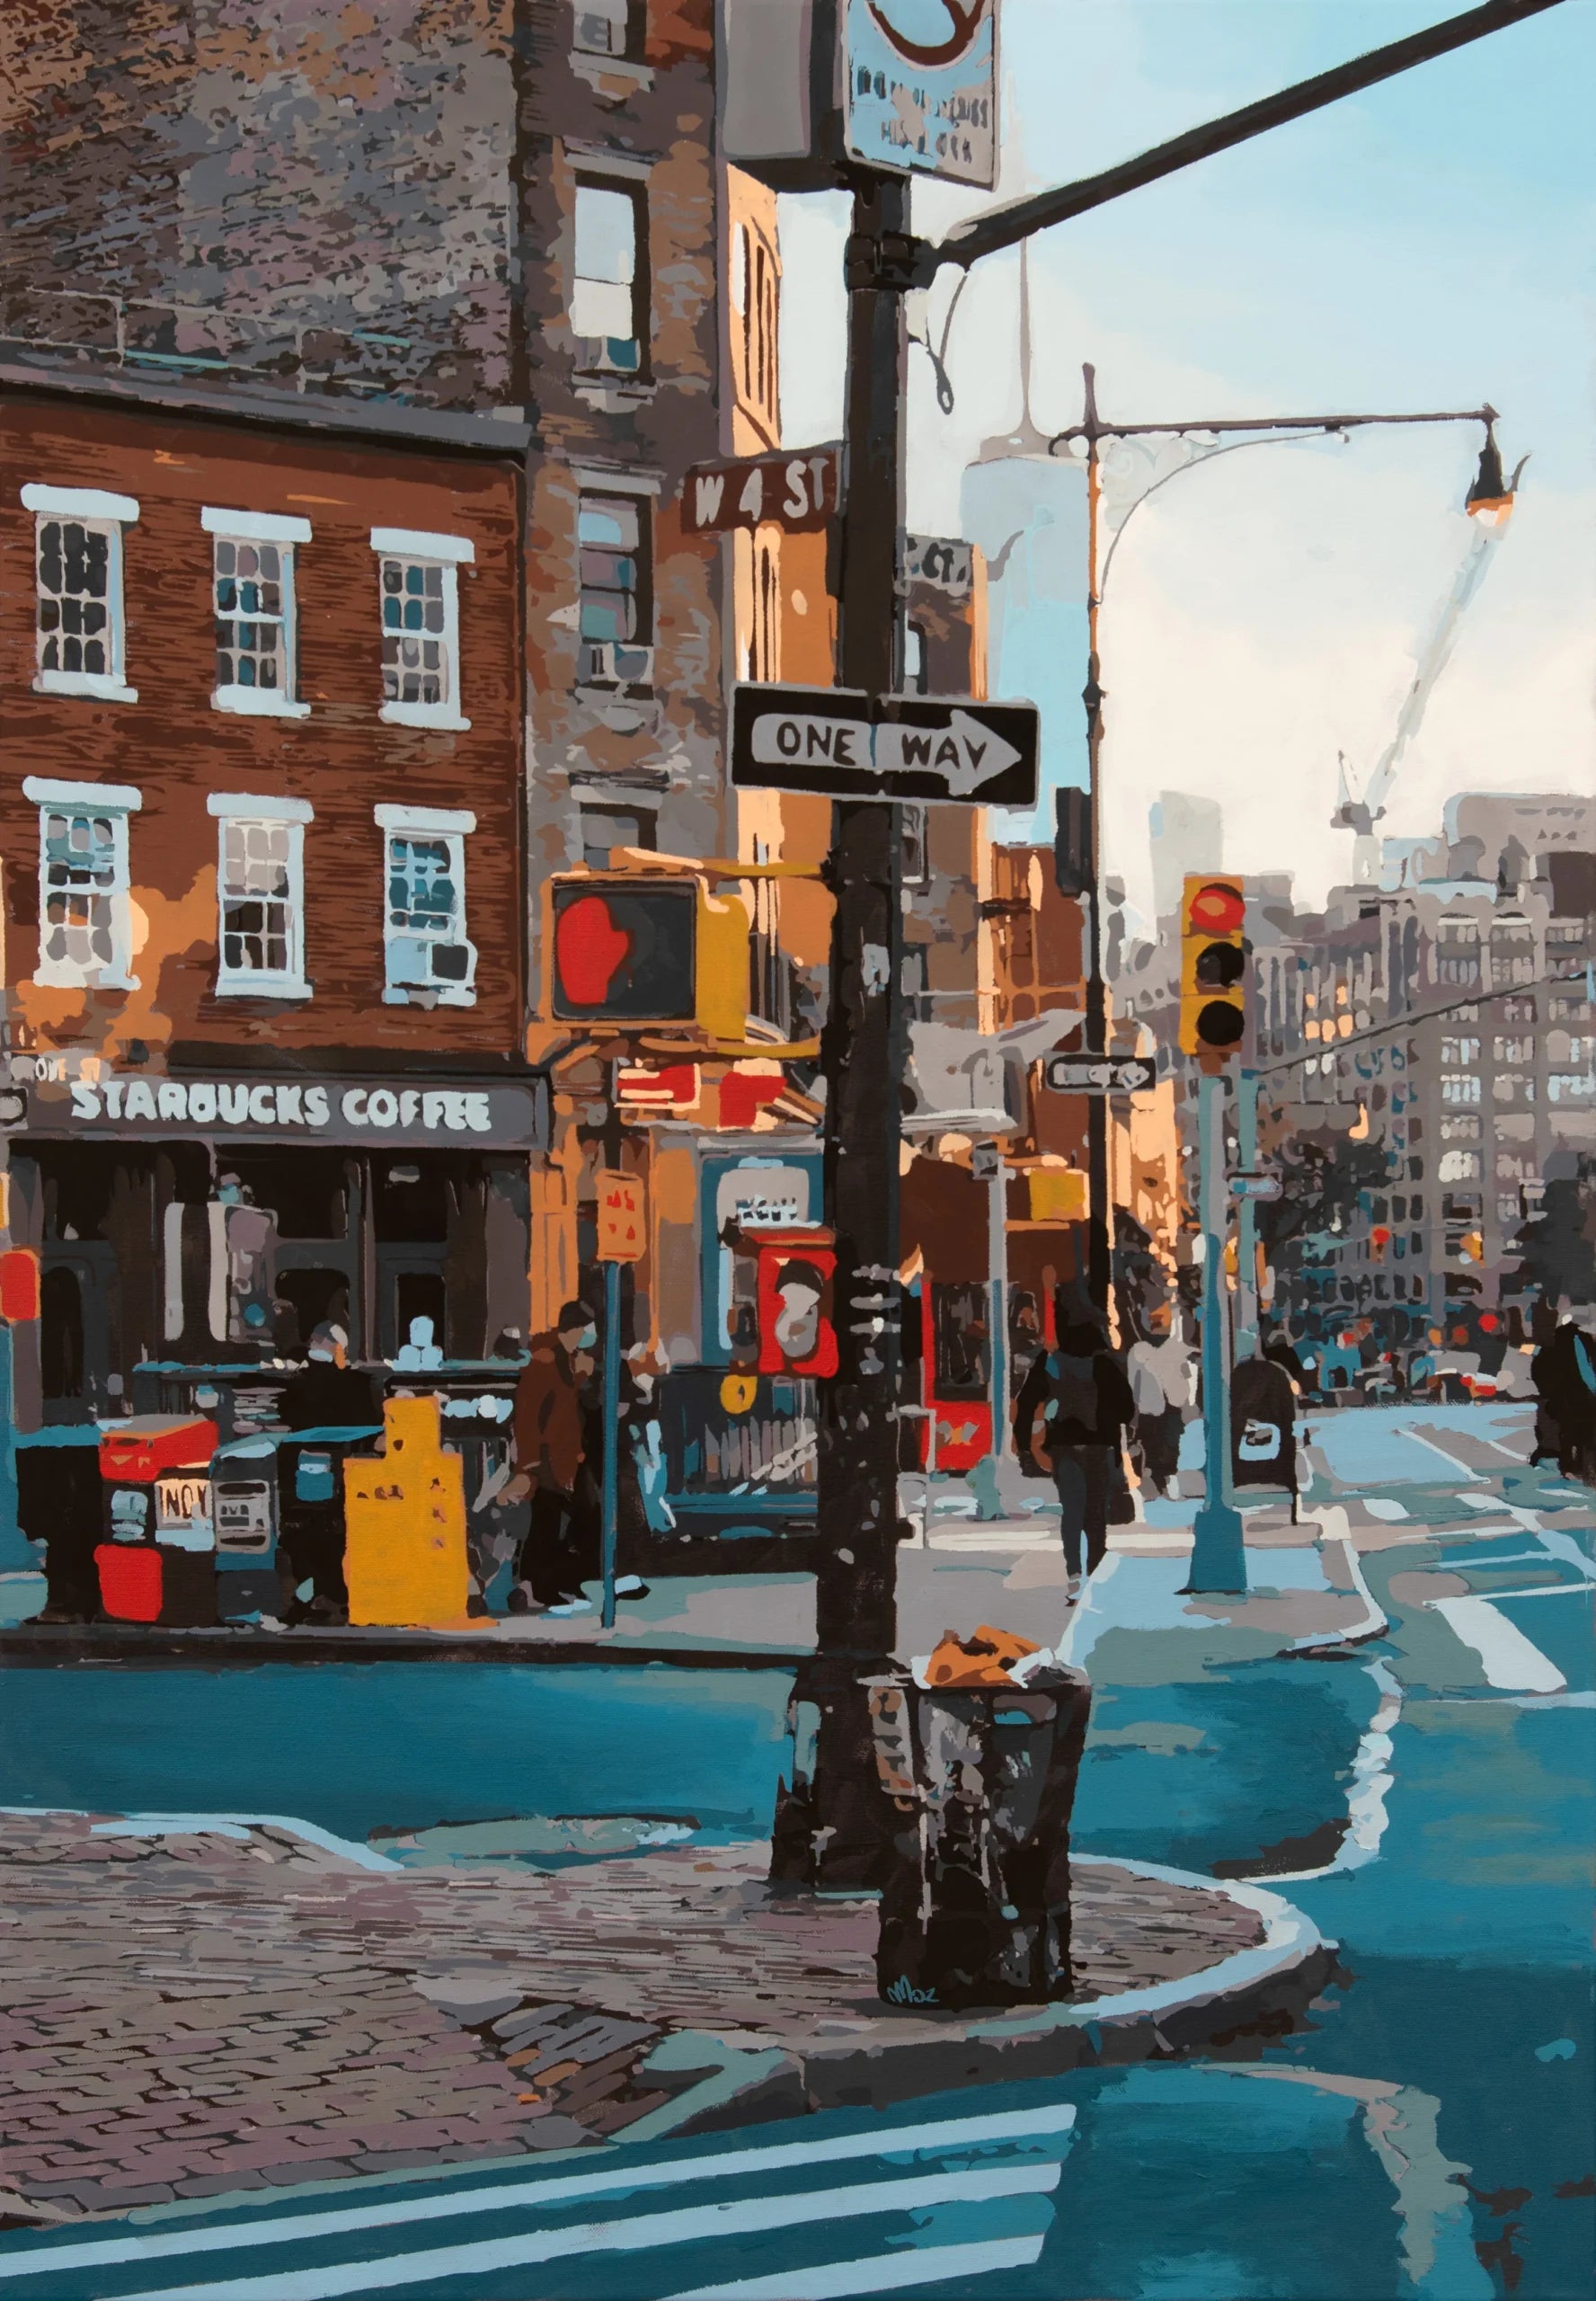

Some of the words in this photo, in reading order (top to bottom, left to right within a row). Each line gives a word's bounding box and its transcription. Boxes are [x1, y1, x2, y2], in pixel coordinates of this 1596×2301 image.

[695, 475, 725, 528] W
[739, 467, 763, 521] 4
[783, 457, 830, 519] ST
[776, 720, 857, 767] ONE
[901, 731, 989, 774] WAY
